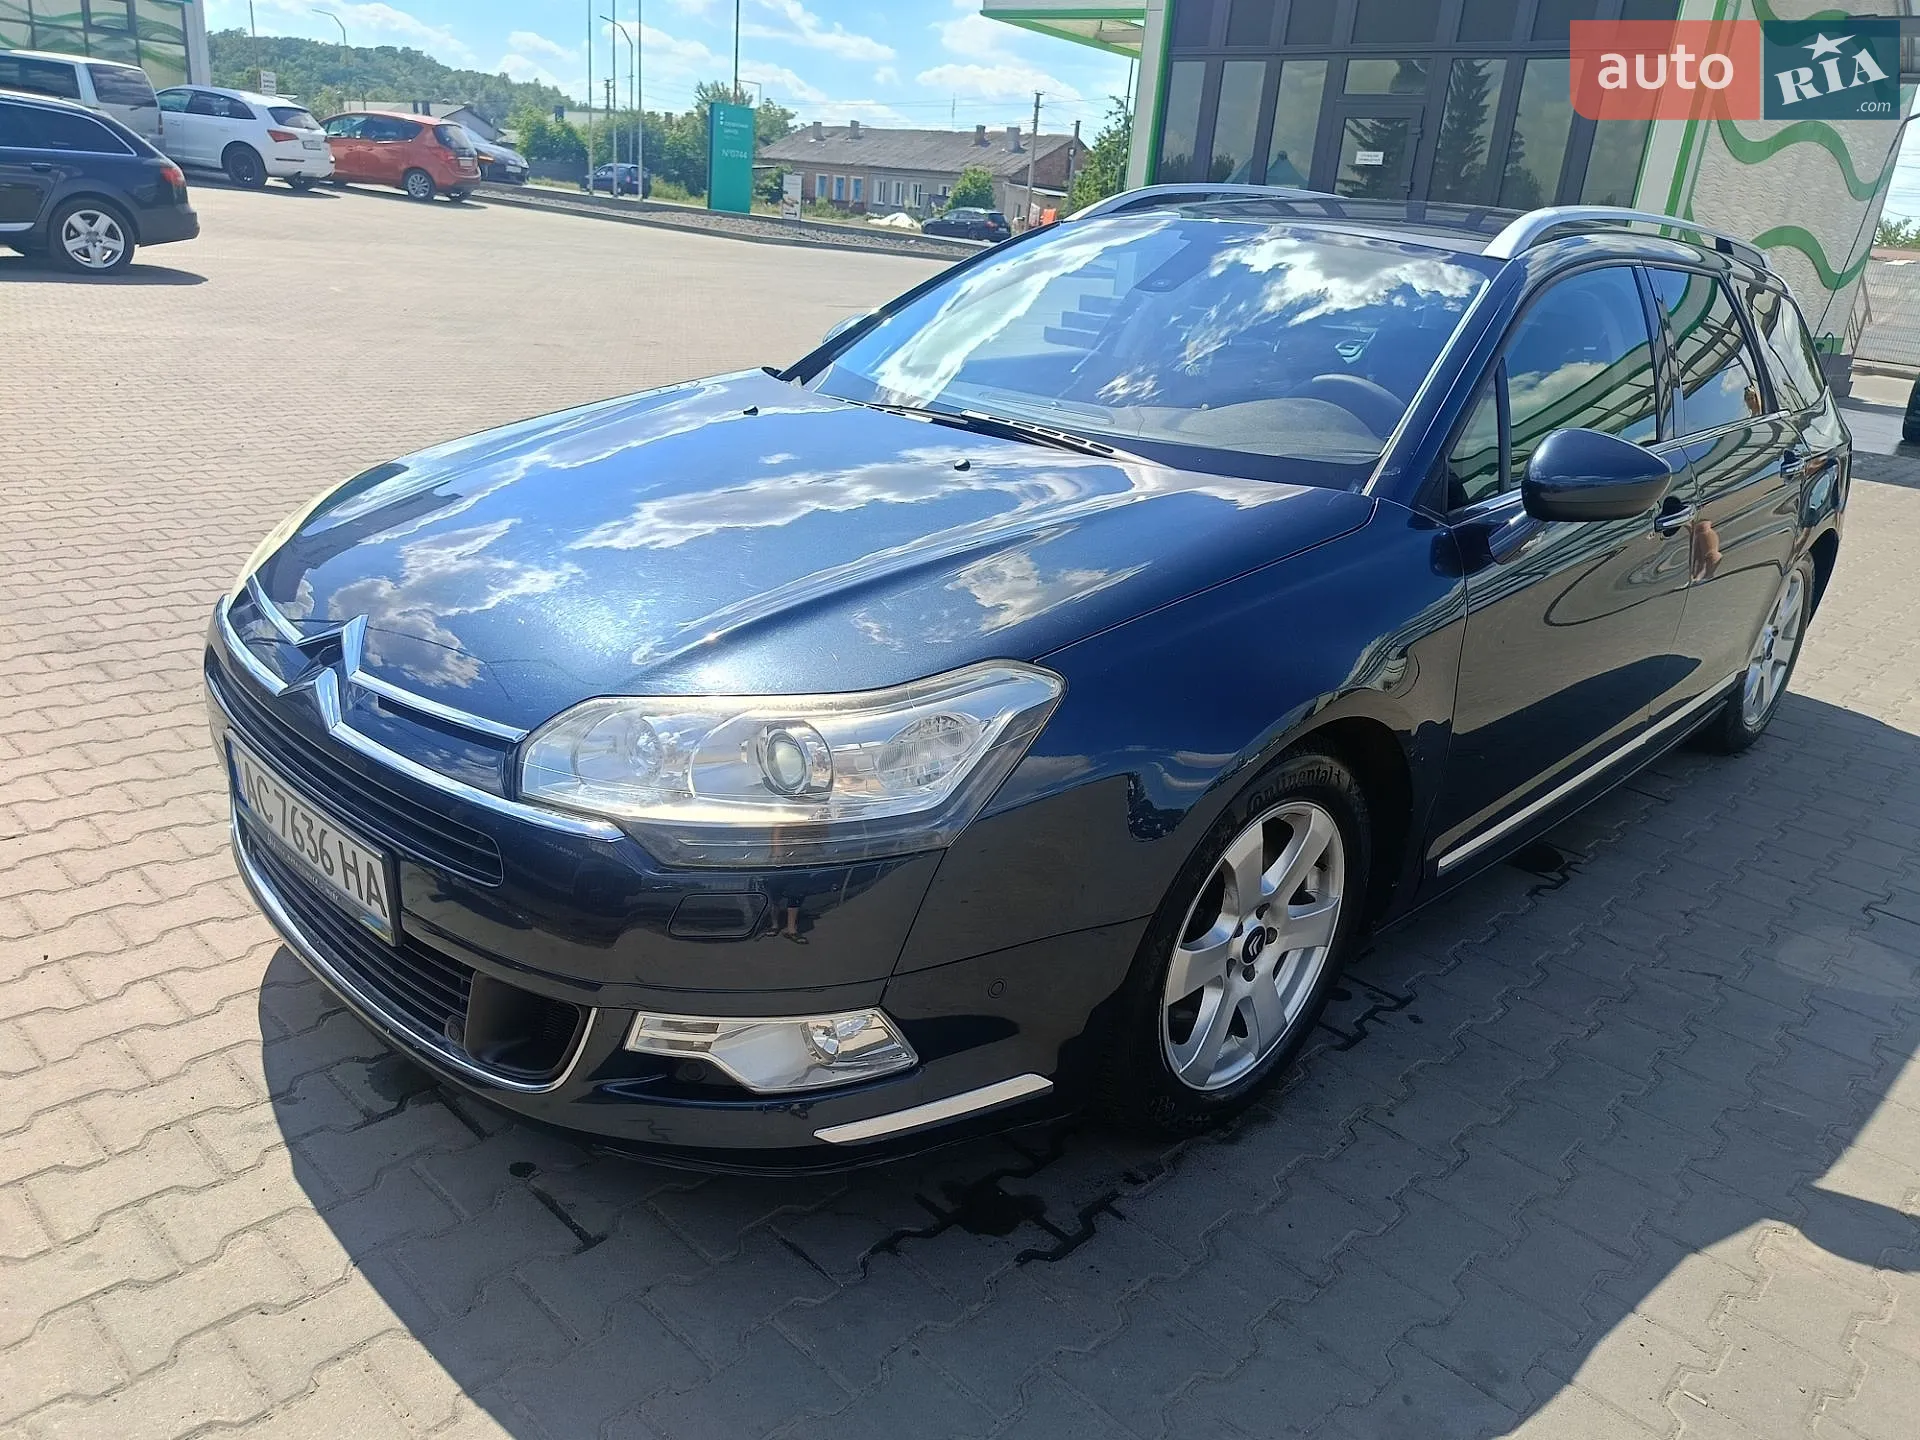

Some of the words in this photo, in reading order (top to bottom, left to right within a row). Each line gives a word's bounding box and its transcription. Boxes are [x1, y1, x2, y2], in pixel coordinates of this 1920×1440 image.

[244, 762, 273, 824] AC
[274, 788, 335, 877] 7636
[338, 840, 387, 918] HA
